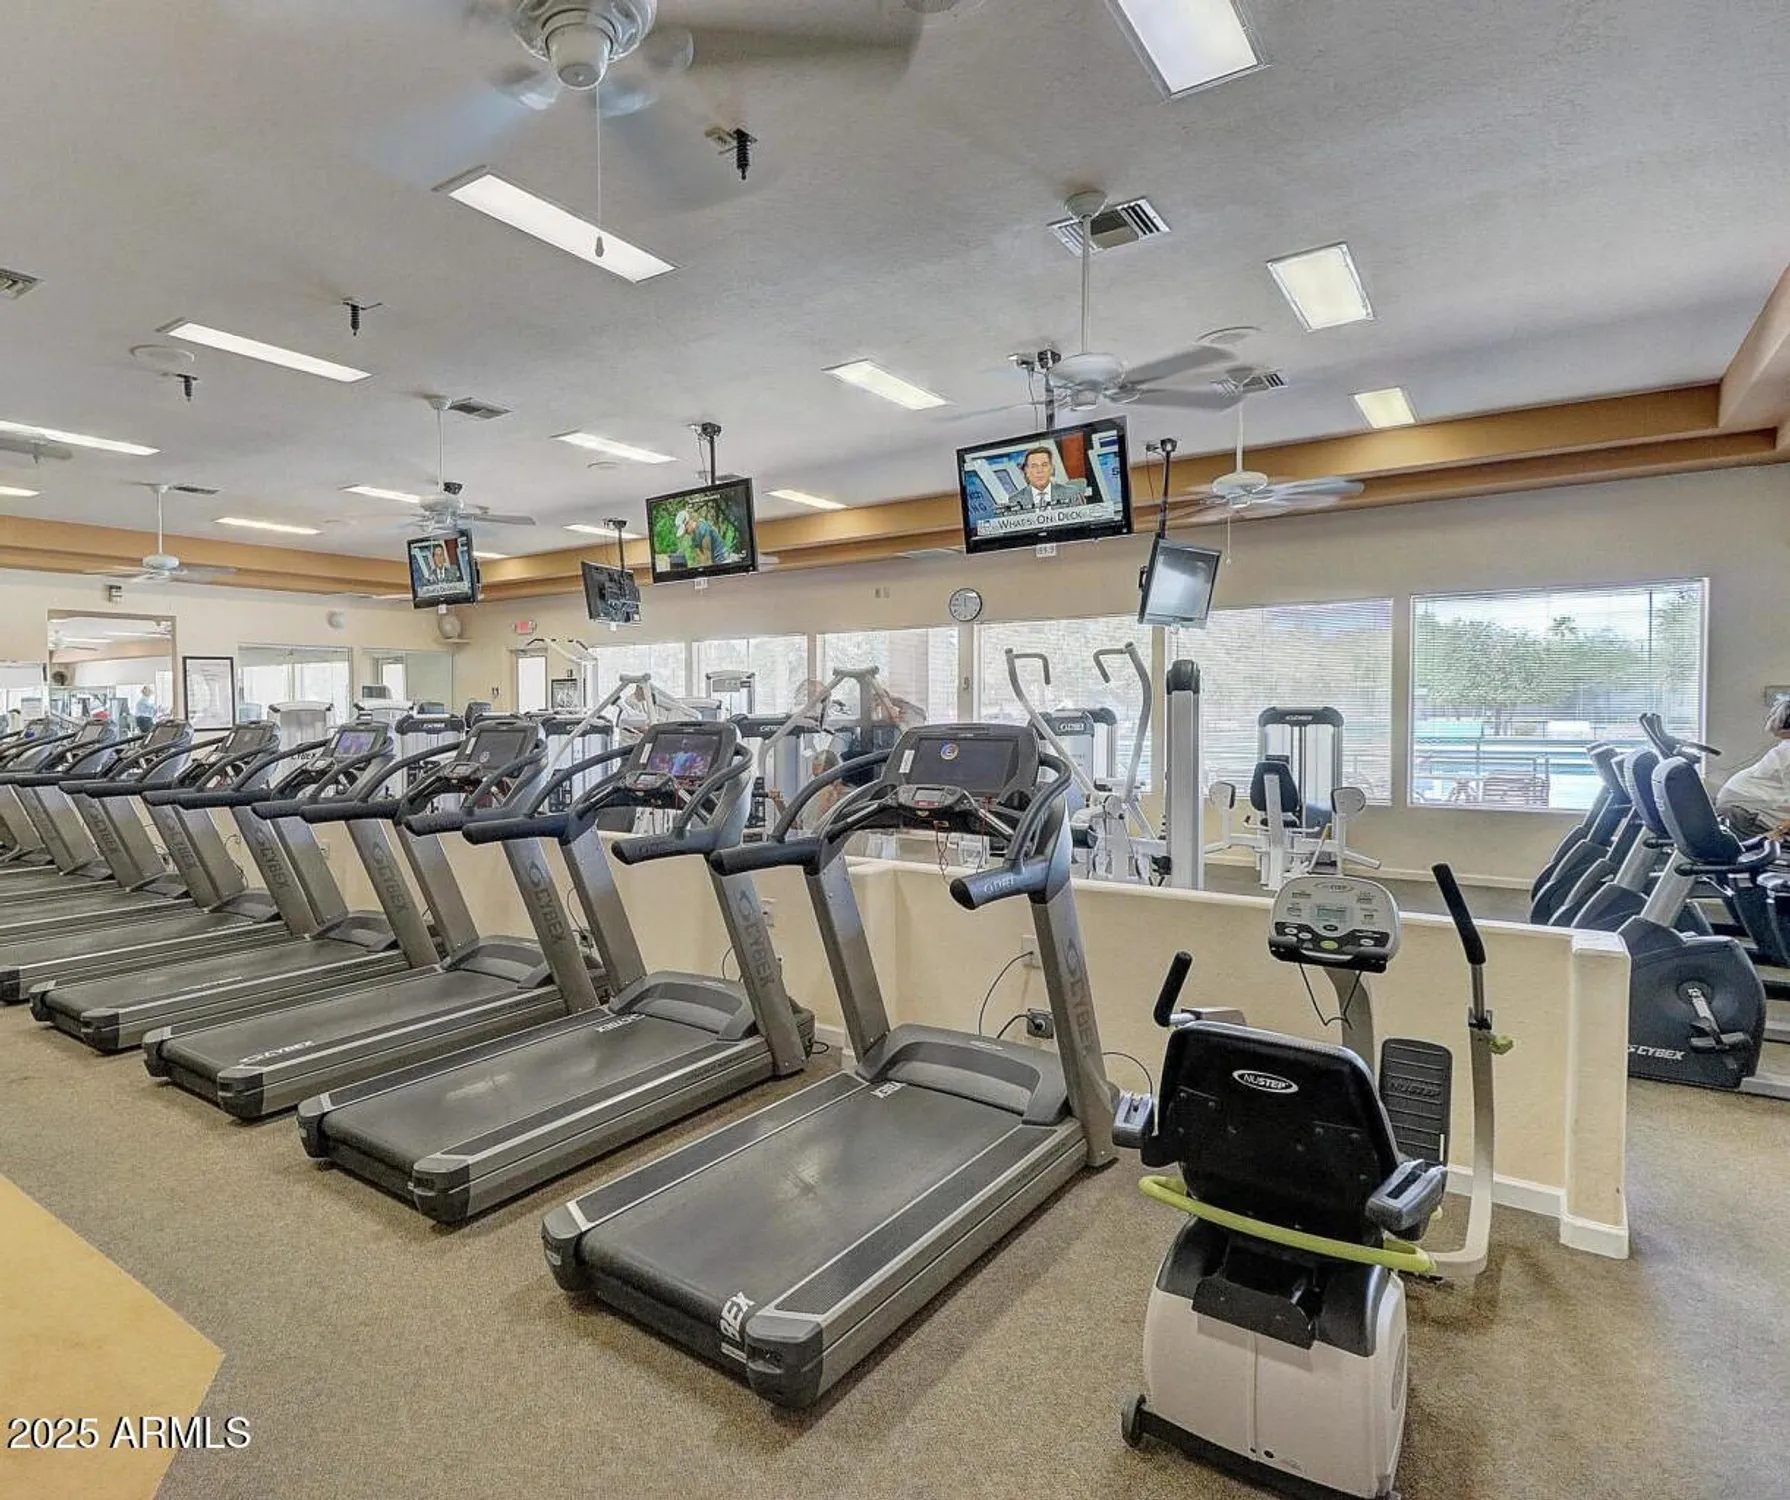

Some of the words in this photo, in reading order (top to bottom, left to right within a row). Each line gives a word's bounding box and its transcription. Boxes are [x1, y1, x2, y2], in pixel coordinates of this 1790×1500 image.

[1037, 513, 1054, 525] ON
[380, 865, 411, 914] CYBEX
[534, 887, 567, 946] CYBEX
[746, 921, 776, 988] CYBEX
[1637, 1045, 1686, 1061] CYBEX
[1243, 1073, 1288, 1090] NUSTEP
